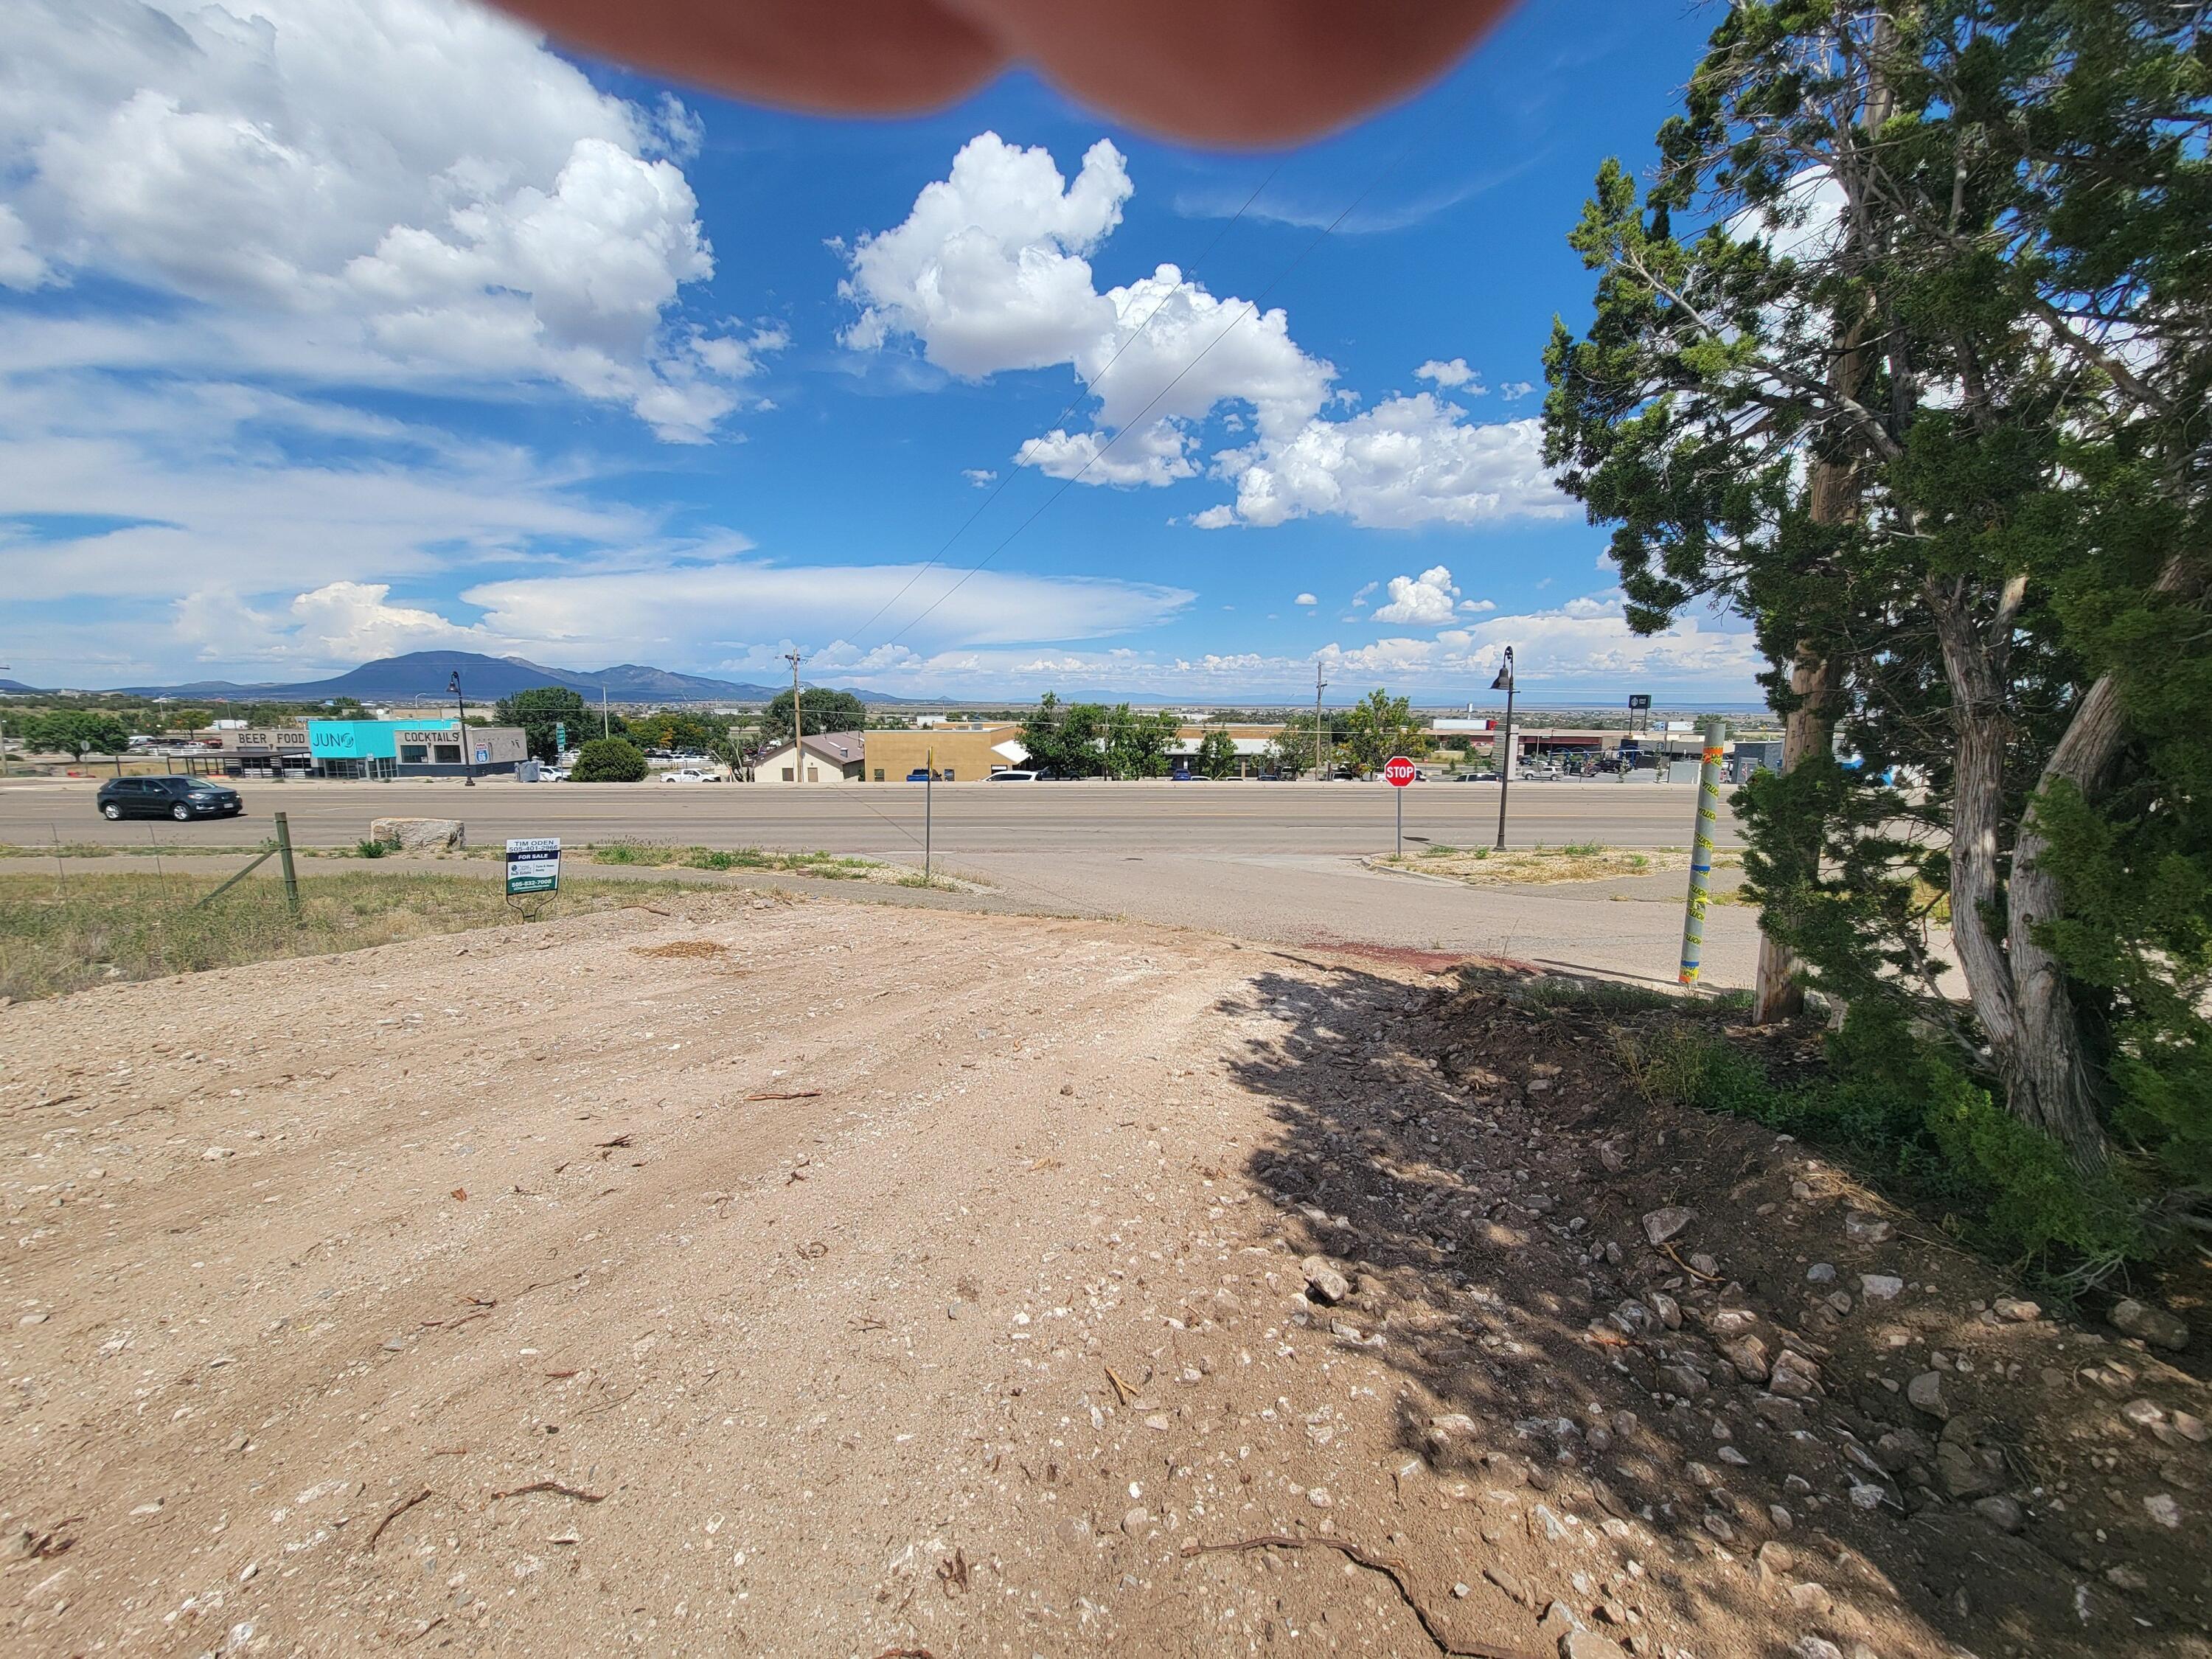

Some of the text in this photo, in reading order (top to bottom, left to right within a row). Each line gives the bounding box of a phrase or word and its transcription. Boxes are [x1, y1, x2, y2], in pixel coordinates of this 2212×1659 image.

[238, 733, 266, 744] BEER
[277, 733, 305, 744] FOOD
[405, 732, 459, 742] COCKTAILS
[479, 753, 486, 762] 66
[1387, 767, 1413, 778] STOP
